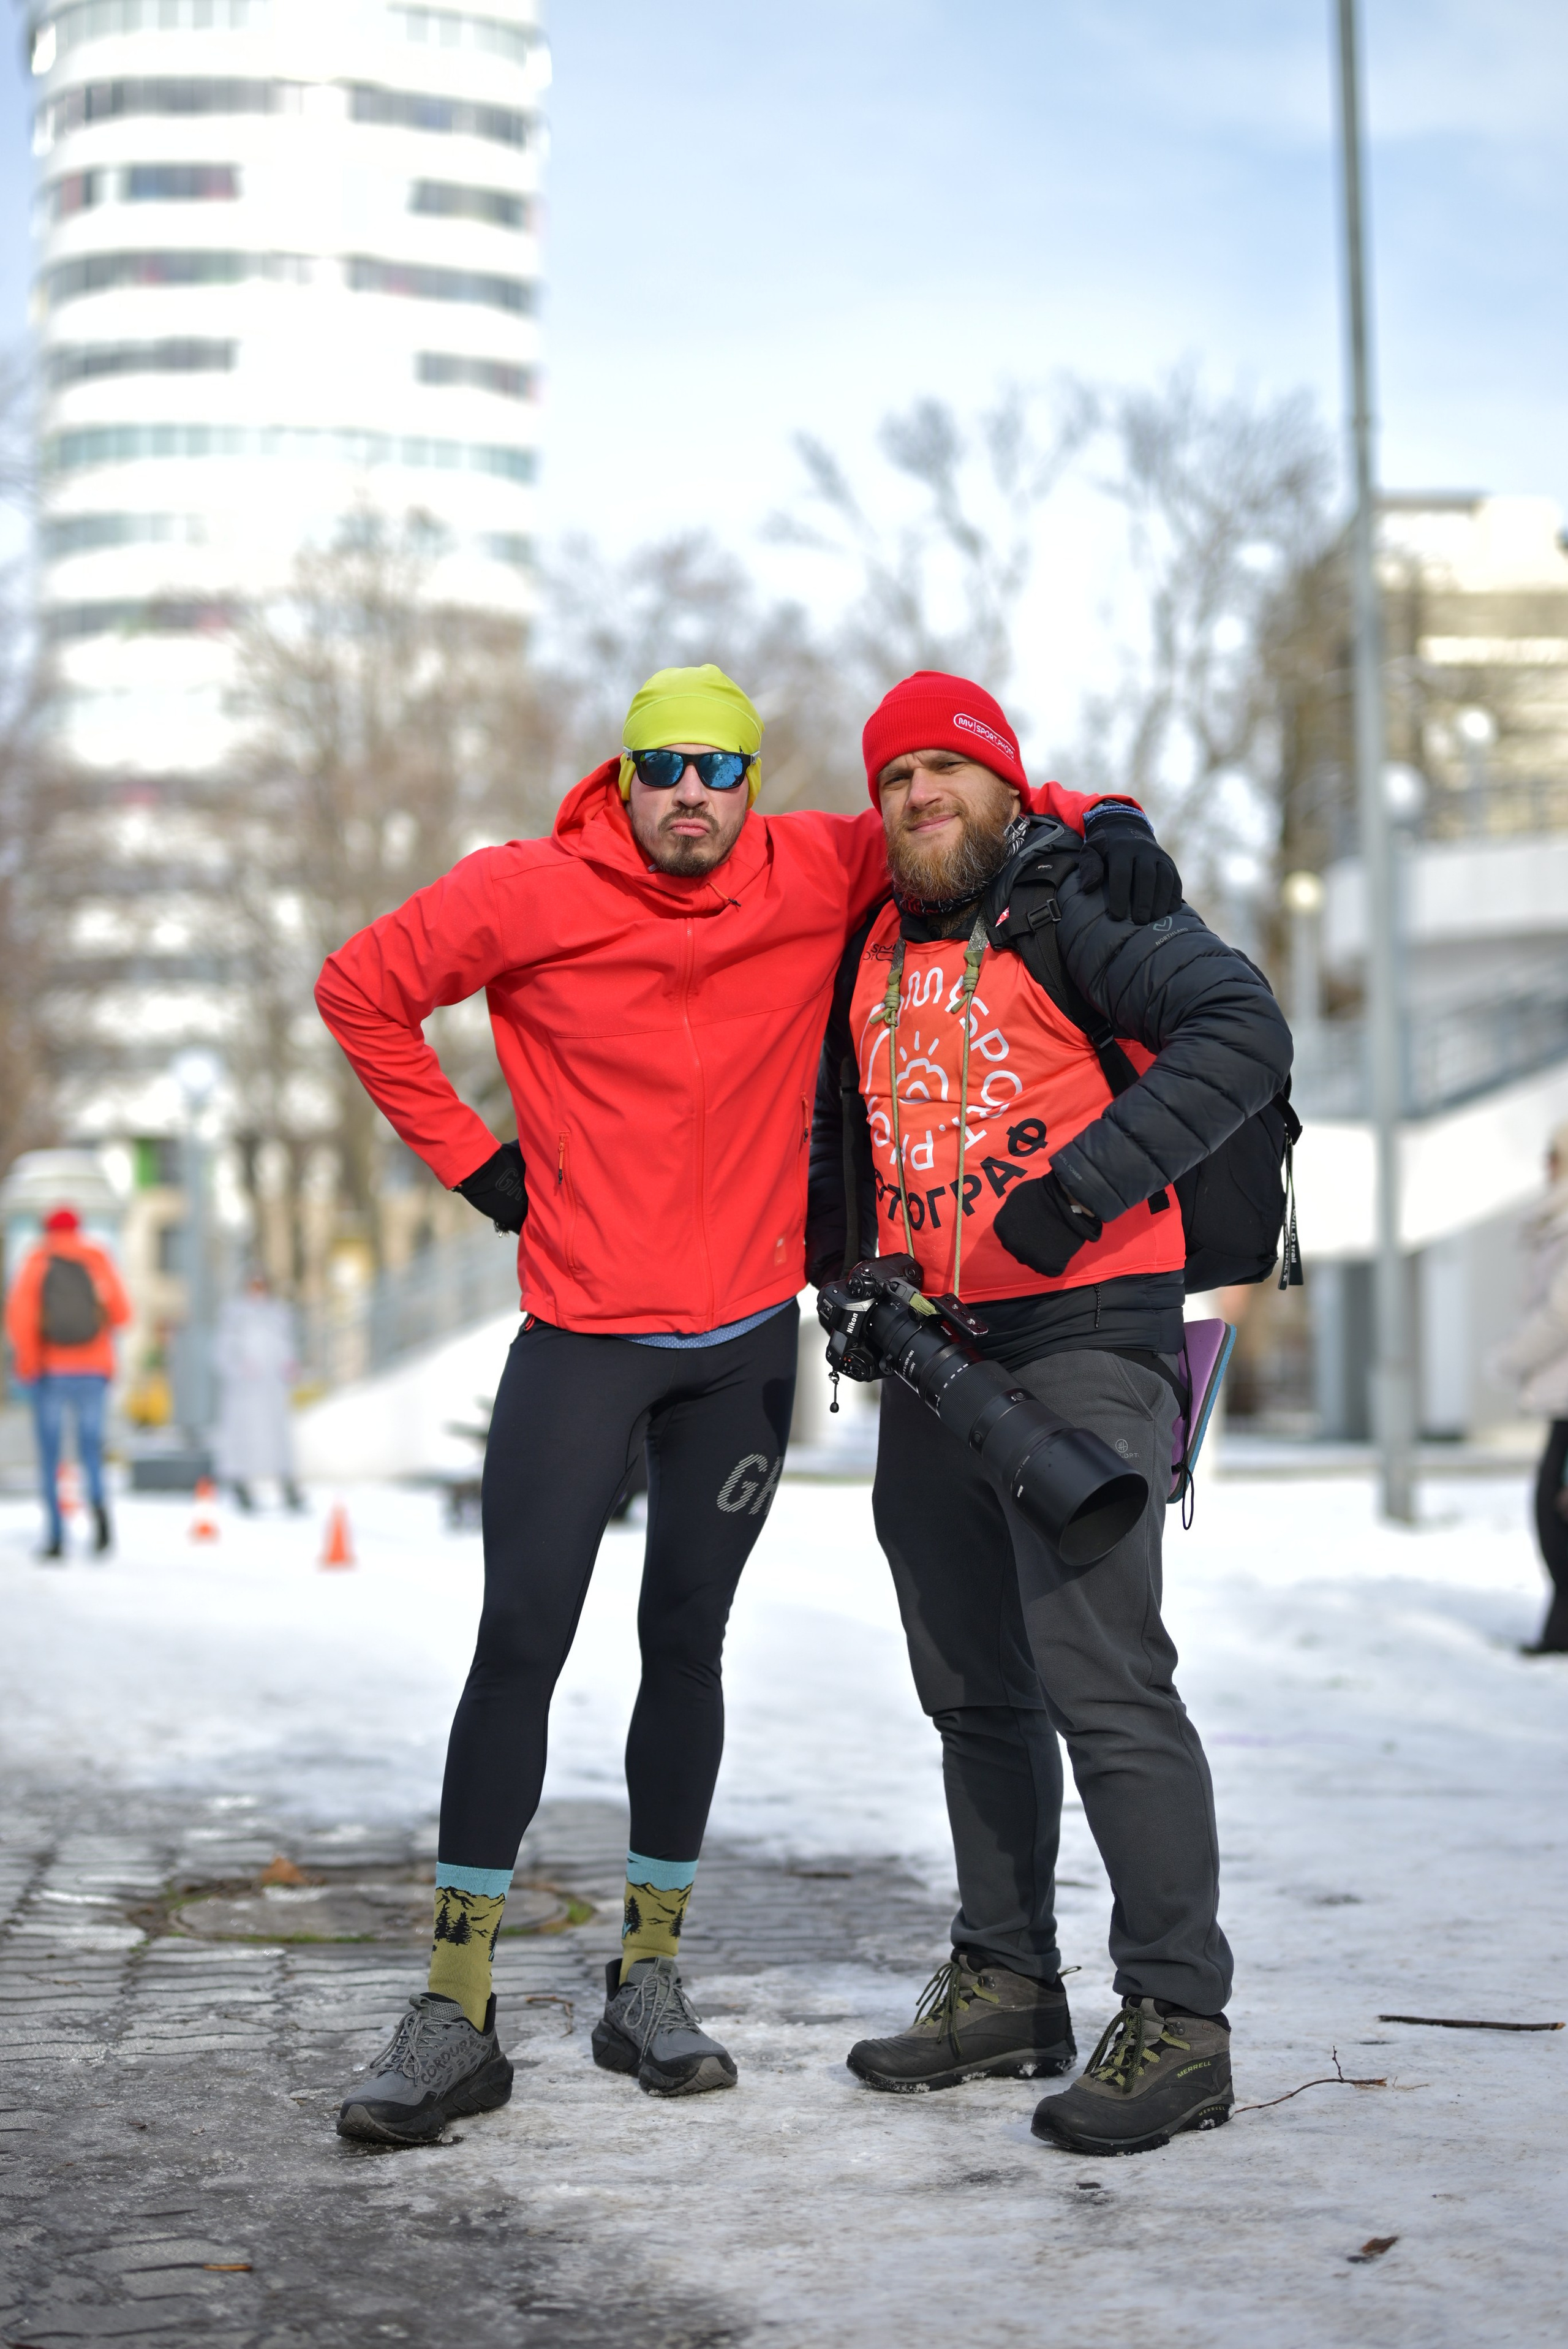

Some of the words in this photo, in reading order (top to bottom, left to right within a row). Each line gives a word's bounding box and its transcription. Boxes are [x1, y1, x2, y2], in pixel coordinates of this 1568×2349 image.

[1155, 927, 1188, 946] NORTHLAND
[846, 1312, 858, 1334] Nikon
[1177, 2060, 1212, 2078] MERRELL
